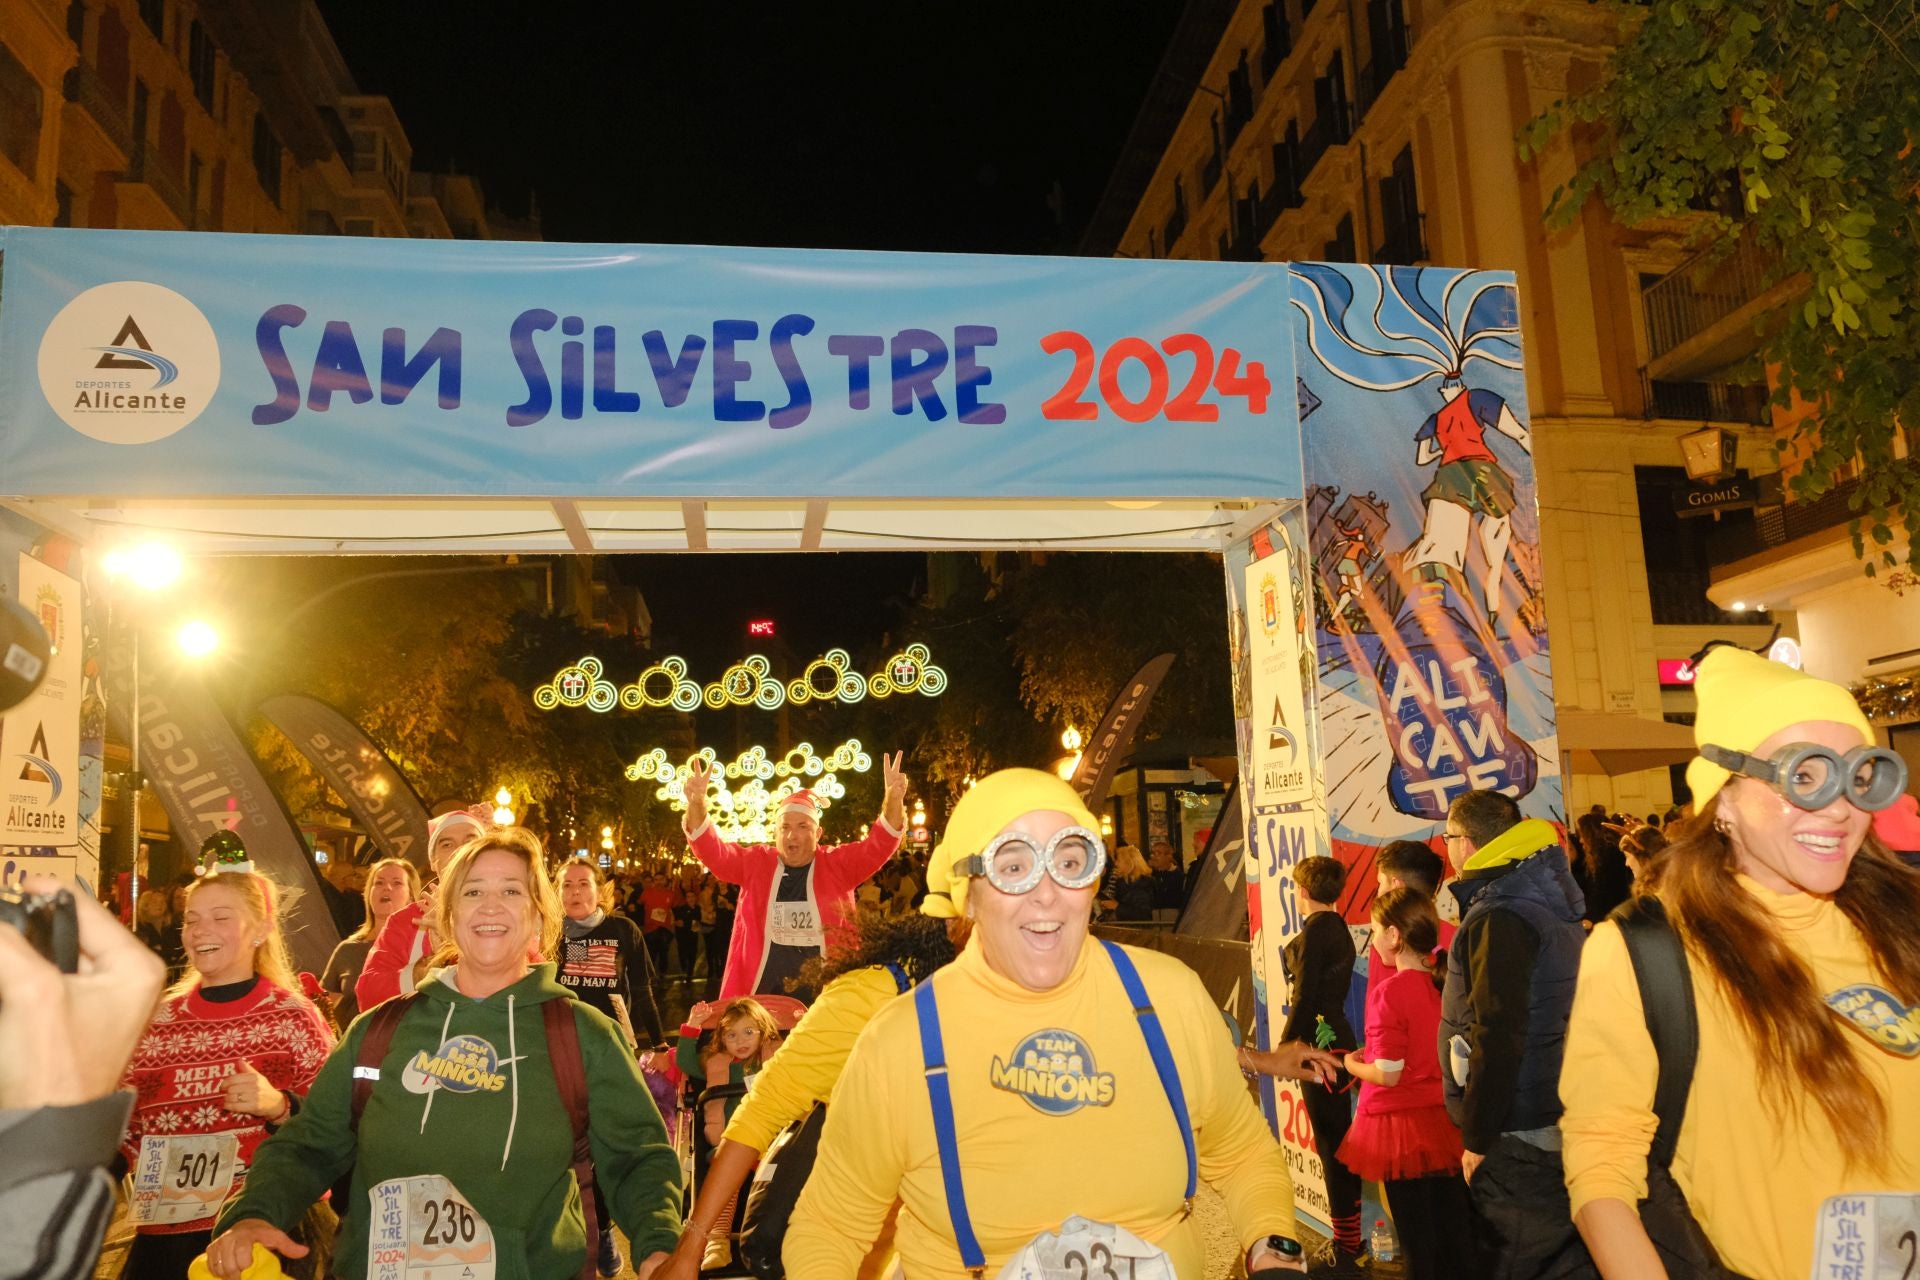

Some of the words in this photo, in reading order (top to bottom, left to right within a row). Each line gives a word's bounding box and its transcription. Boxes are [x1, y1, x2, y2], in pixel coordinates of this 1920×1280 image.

[251, 303, 462, 426] SAN
[1039, 330, 1271, 424] 2024
[75, 381, 132, 389] DEPORTES
[74, 390, 186, 409] Alicante
[1389, 656, 1491, 714] ALI
[1400, 712, 1505, 769] CAN
[1264, 770, 1303, 790] Alicante
[1405, 759, 1520, 813] TE
[7, 805, 65, 829] Alicante
[1266, 818, 1307, 877] SAN
[1279, 876, 1304, 937] Si
[791, 912, 813, 929] 322
[560, 975, 579, 986] OLD
[582, 976, 605, 988] MAN
[608, 978, 618, 988] IN
[460, 1039, 489, 1055] TEAM
[1035, 1038, 1077, 1052] TEAM
[173, 1063, 238, 1083] MERR
[415, 1051, 507, 1092] MINIONS
[991, 1056, 1115, 1105] MINIONS
[1280, 1090, 1318, 1153] 20
[146, 1161, 162, 1173] VES
[176, 1152, 220, 1189] 501
[1309, 1158, 1324, 1180] 19:3
[143, 1173, 160, 1183] TRE
[135, 1190, 160, 1201] 2024
[378, 1184, 402, 1198] SAN
[382, 1211, 402, 1226] VES
[1829, 1199, 1866, 1218] SAN
[423, 1198, 476, 1246] 236
[380, 1226, 402, 1240] TRE
[374, 1250, 406, 1265] 2024
[1831, 1240, 1866, 1263] VES
[379, 1263, 397, 1273] ALI
